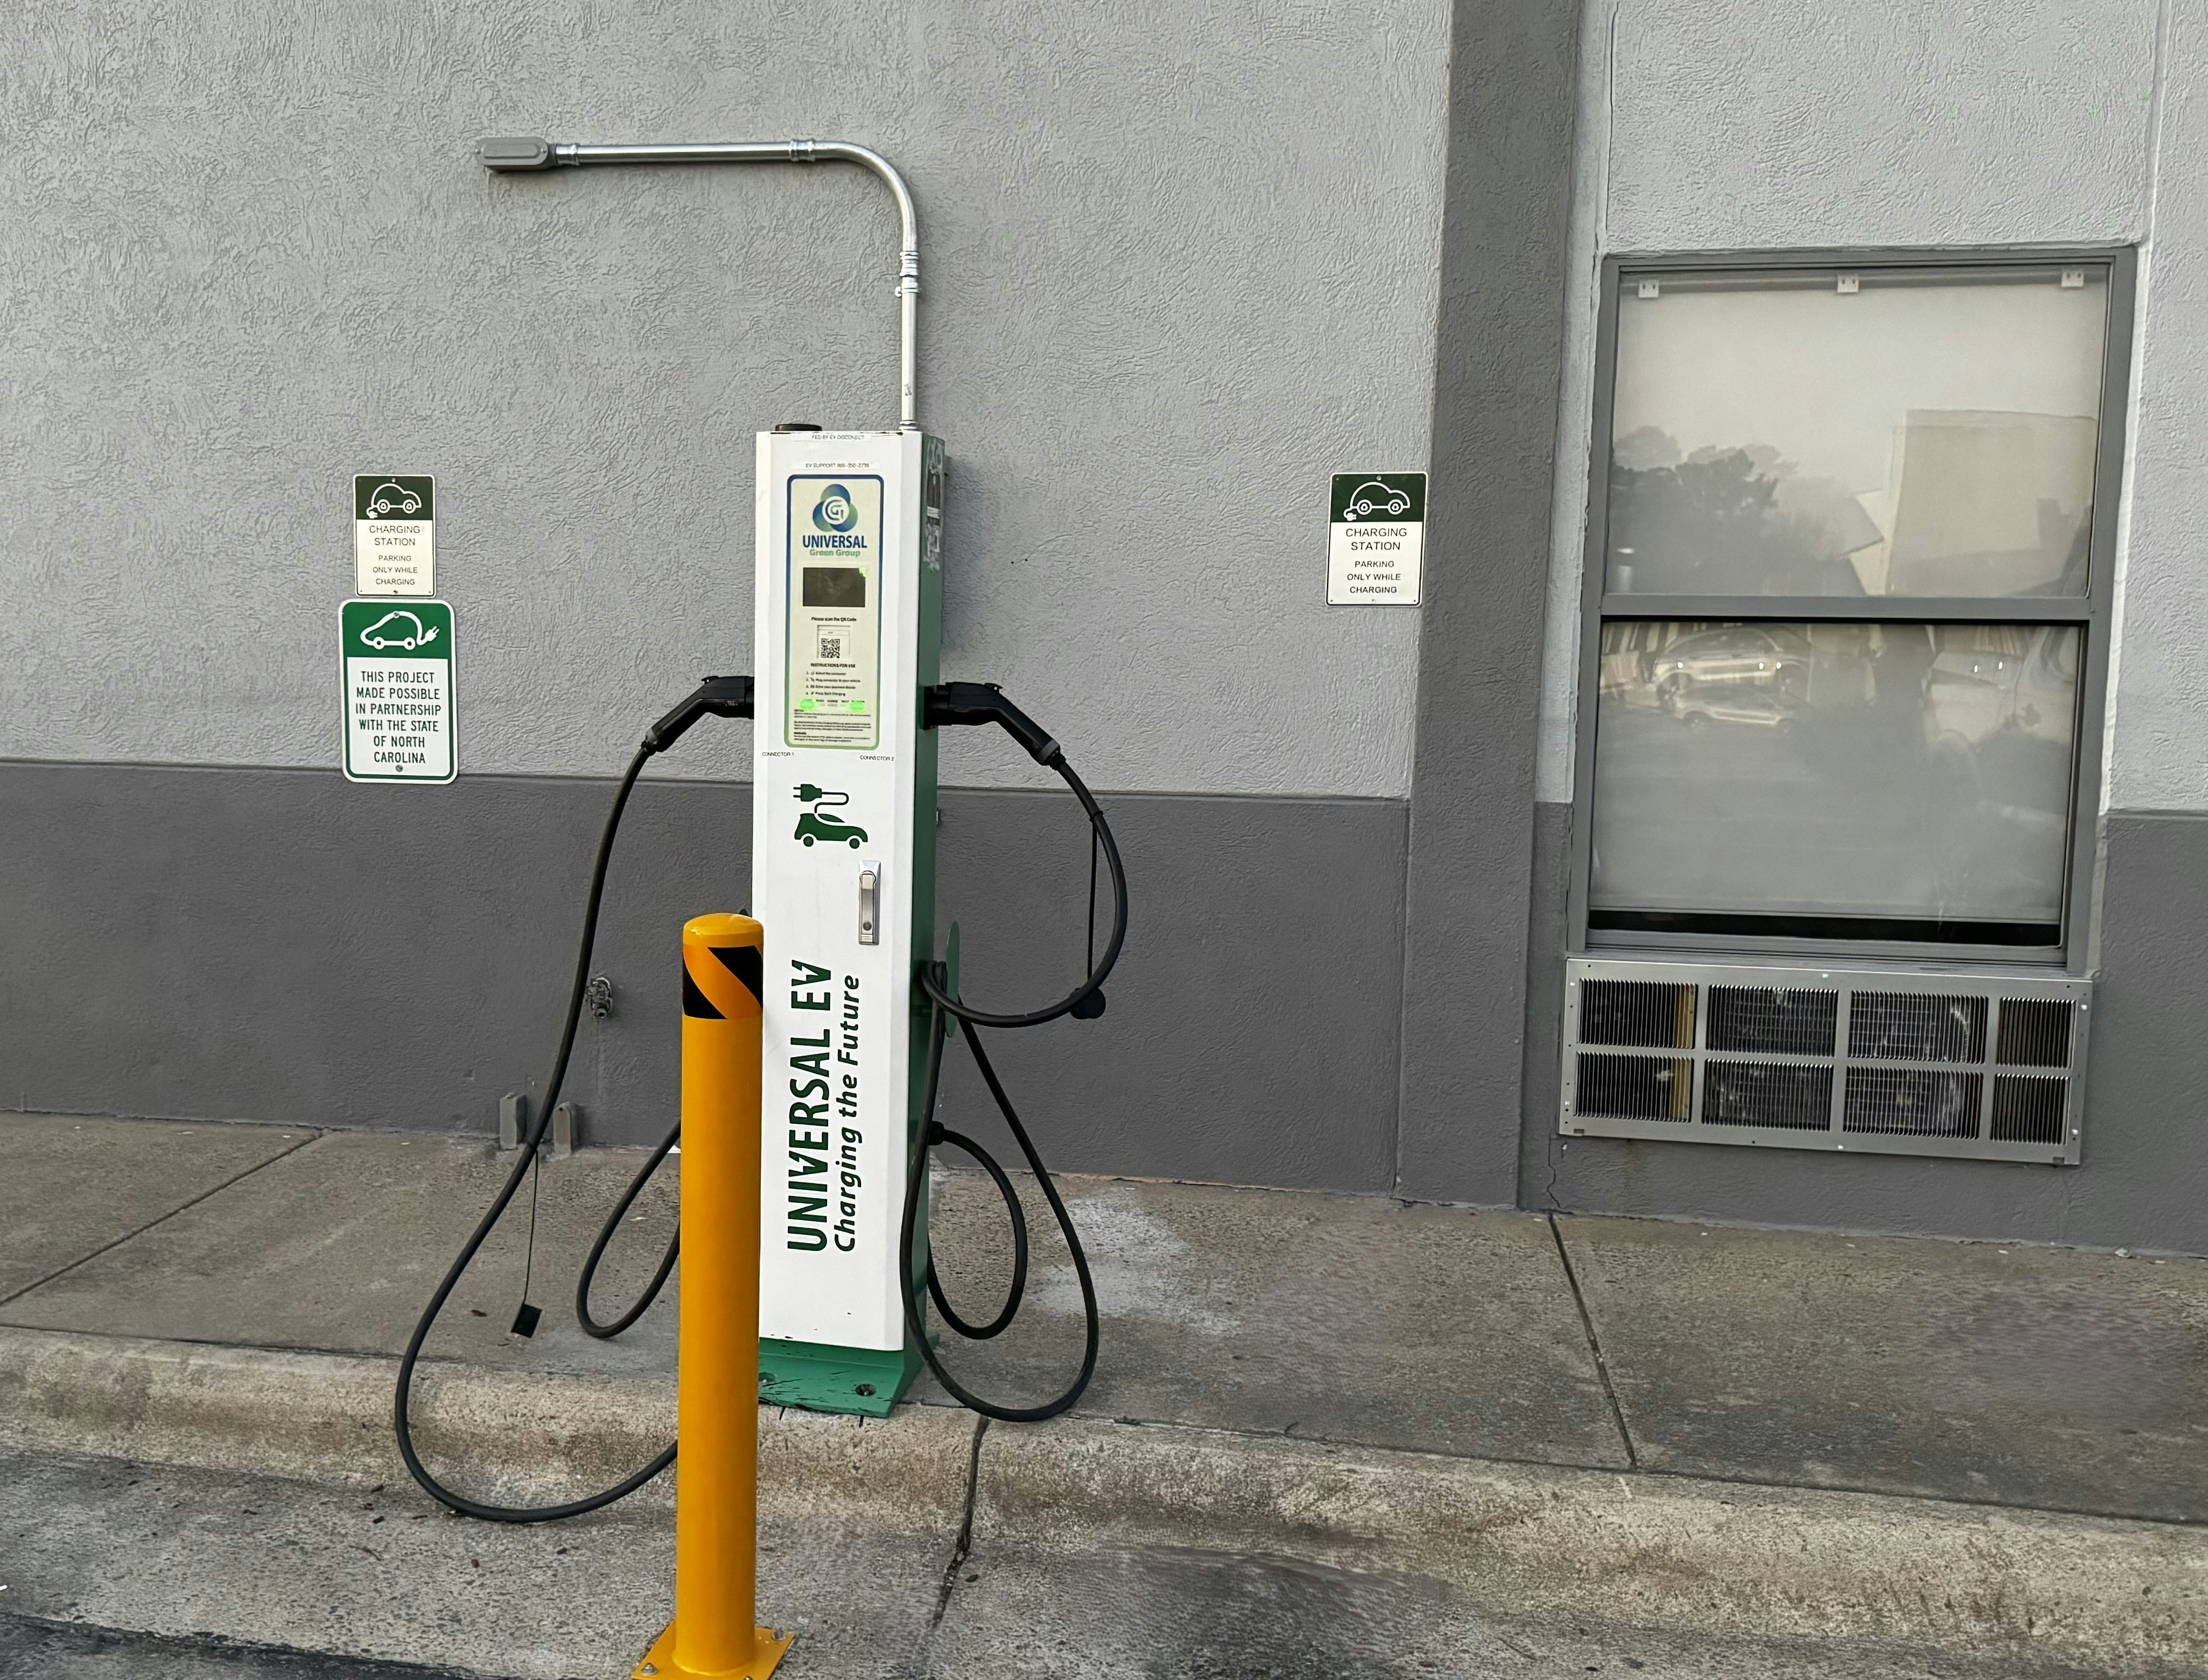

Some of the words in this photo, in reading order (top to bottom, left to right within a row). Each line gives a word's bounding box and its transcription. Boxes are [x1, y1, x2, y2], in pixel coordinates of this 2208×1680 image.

[1345, 528, 1407, 537] CHARGING
[374, 538, 416, 546] STATION
[802, 535, 867, 548] UNIVERSAL
[1351, 542, 1400, 551] STATION
[836, 549, 860, 557] Group
[361, 671, 384, 683] THIS
[388, 671, 434, 683] PROJECT
[356, 687, 385, 698] MADE
[390, 688, 440, 700] POSSIBLE
[356, 703, 366, 714] IN
[370, 704, 441, 715] PARTNERSHIP
[359, 719, 383, 730] WITH
[387, 720, 406, 731] THE
[411, 720, 439, 732] STATE
[374, 735, 387, 747] OF
[391, 736, 425, 748] NORTH
[374, 751, 425, 763] CAROLINA
[791, 959, 831, 1011] EV
[837, 974, 860, 1066] Future
[836, 1074, 858, 1118] the
[787, 1029, 830, 1252] UNIVERSAL
[834, 1127, 863, 1252] Charging
